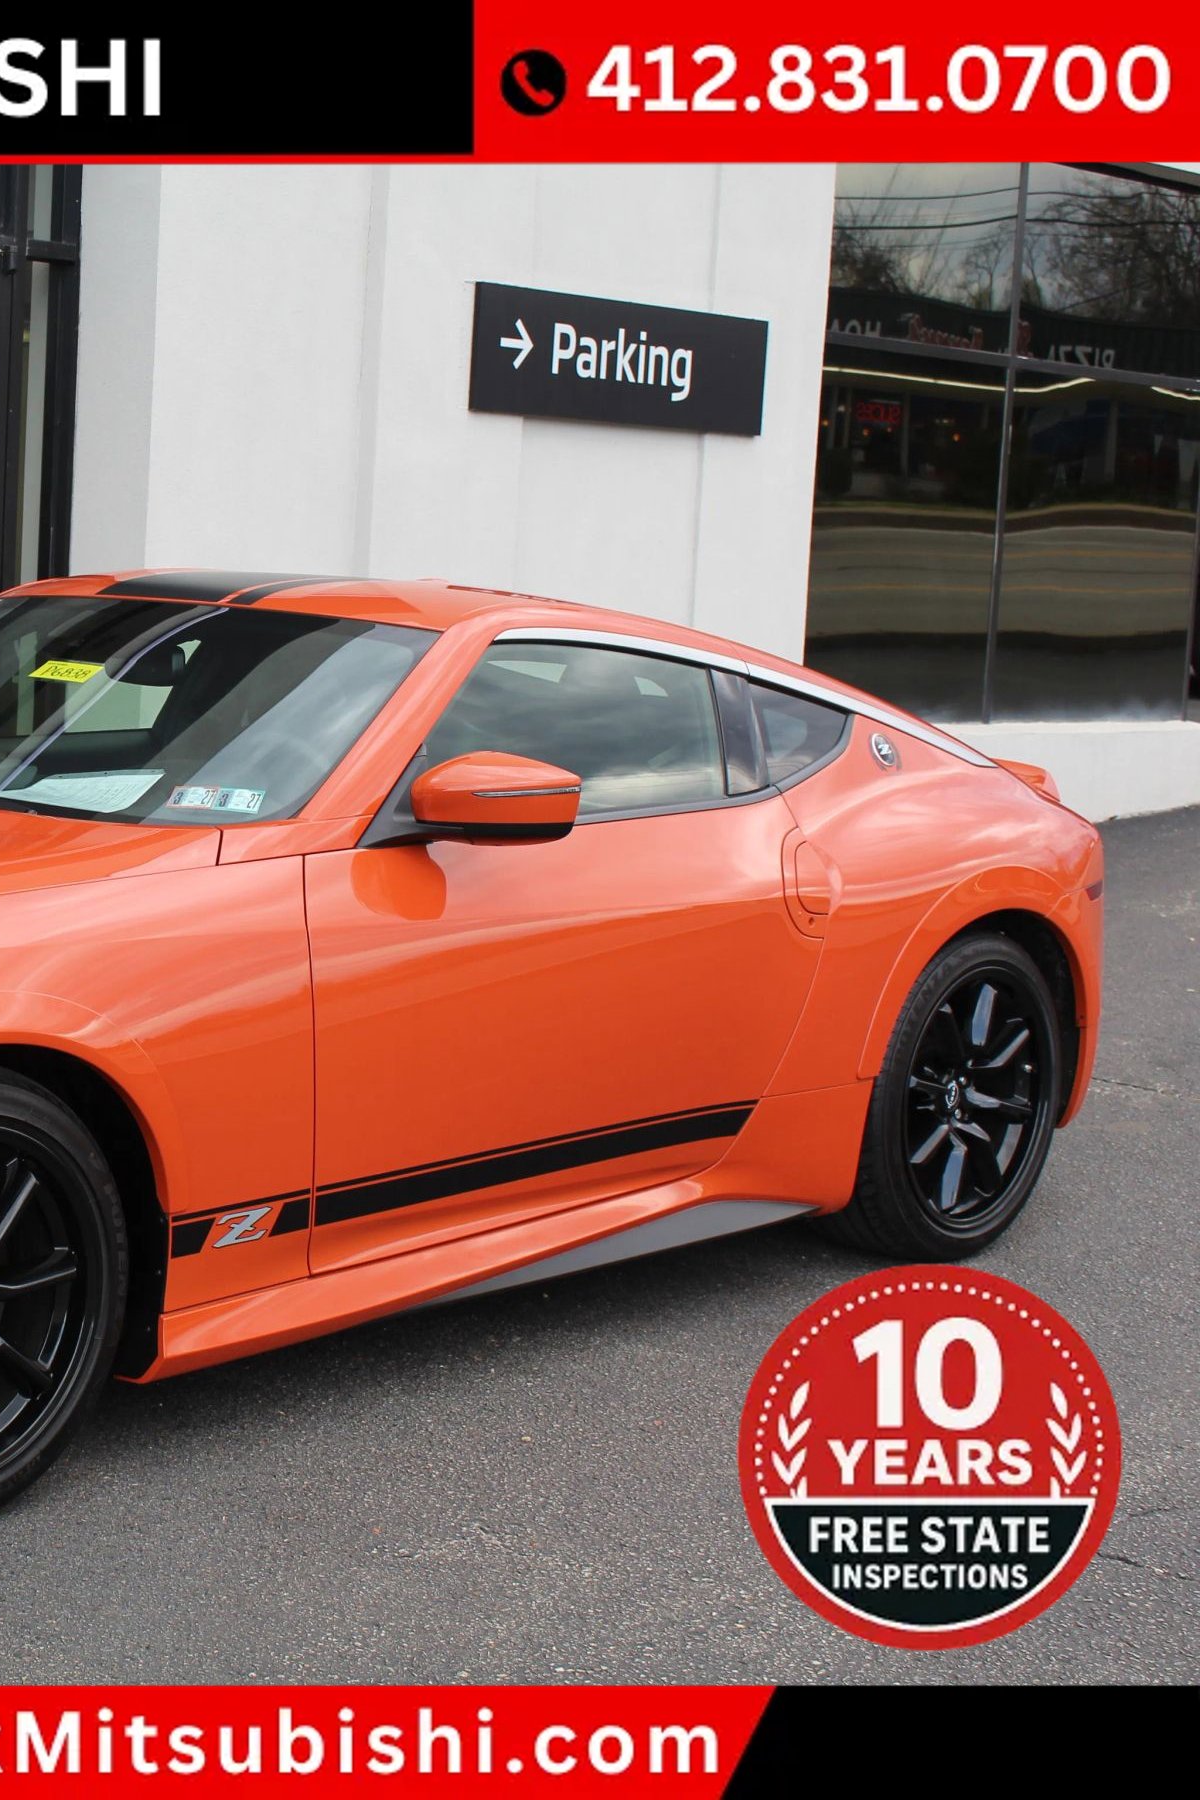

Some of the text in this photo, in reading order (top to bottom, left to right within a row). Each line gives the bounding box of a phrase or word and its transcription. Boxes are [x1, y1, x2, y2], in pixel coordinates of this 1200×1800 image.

[552, 322, 693, 402] Parking
[200, 789, 217, 804] 27
[247, 793, 261, 809] 27
[212, 1205, 273, 1249] Z
